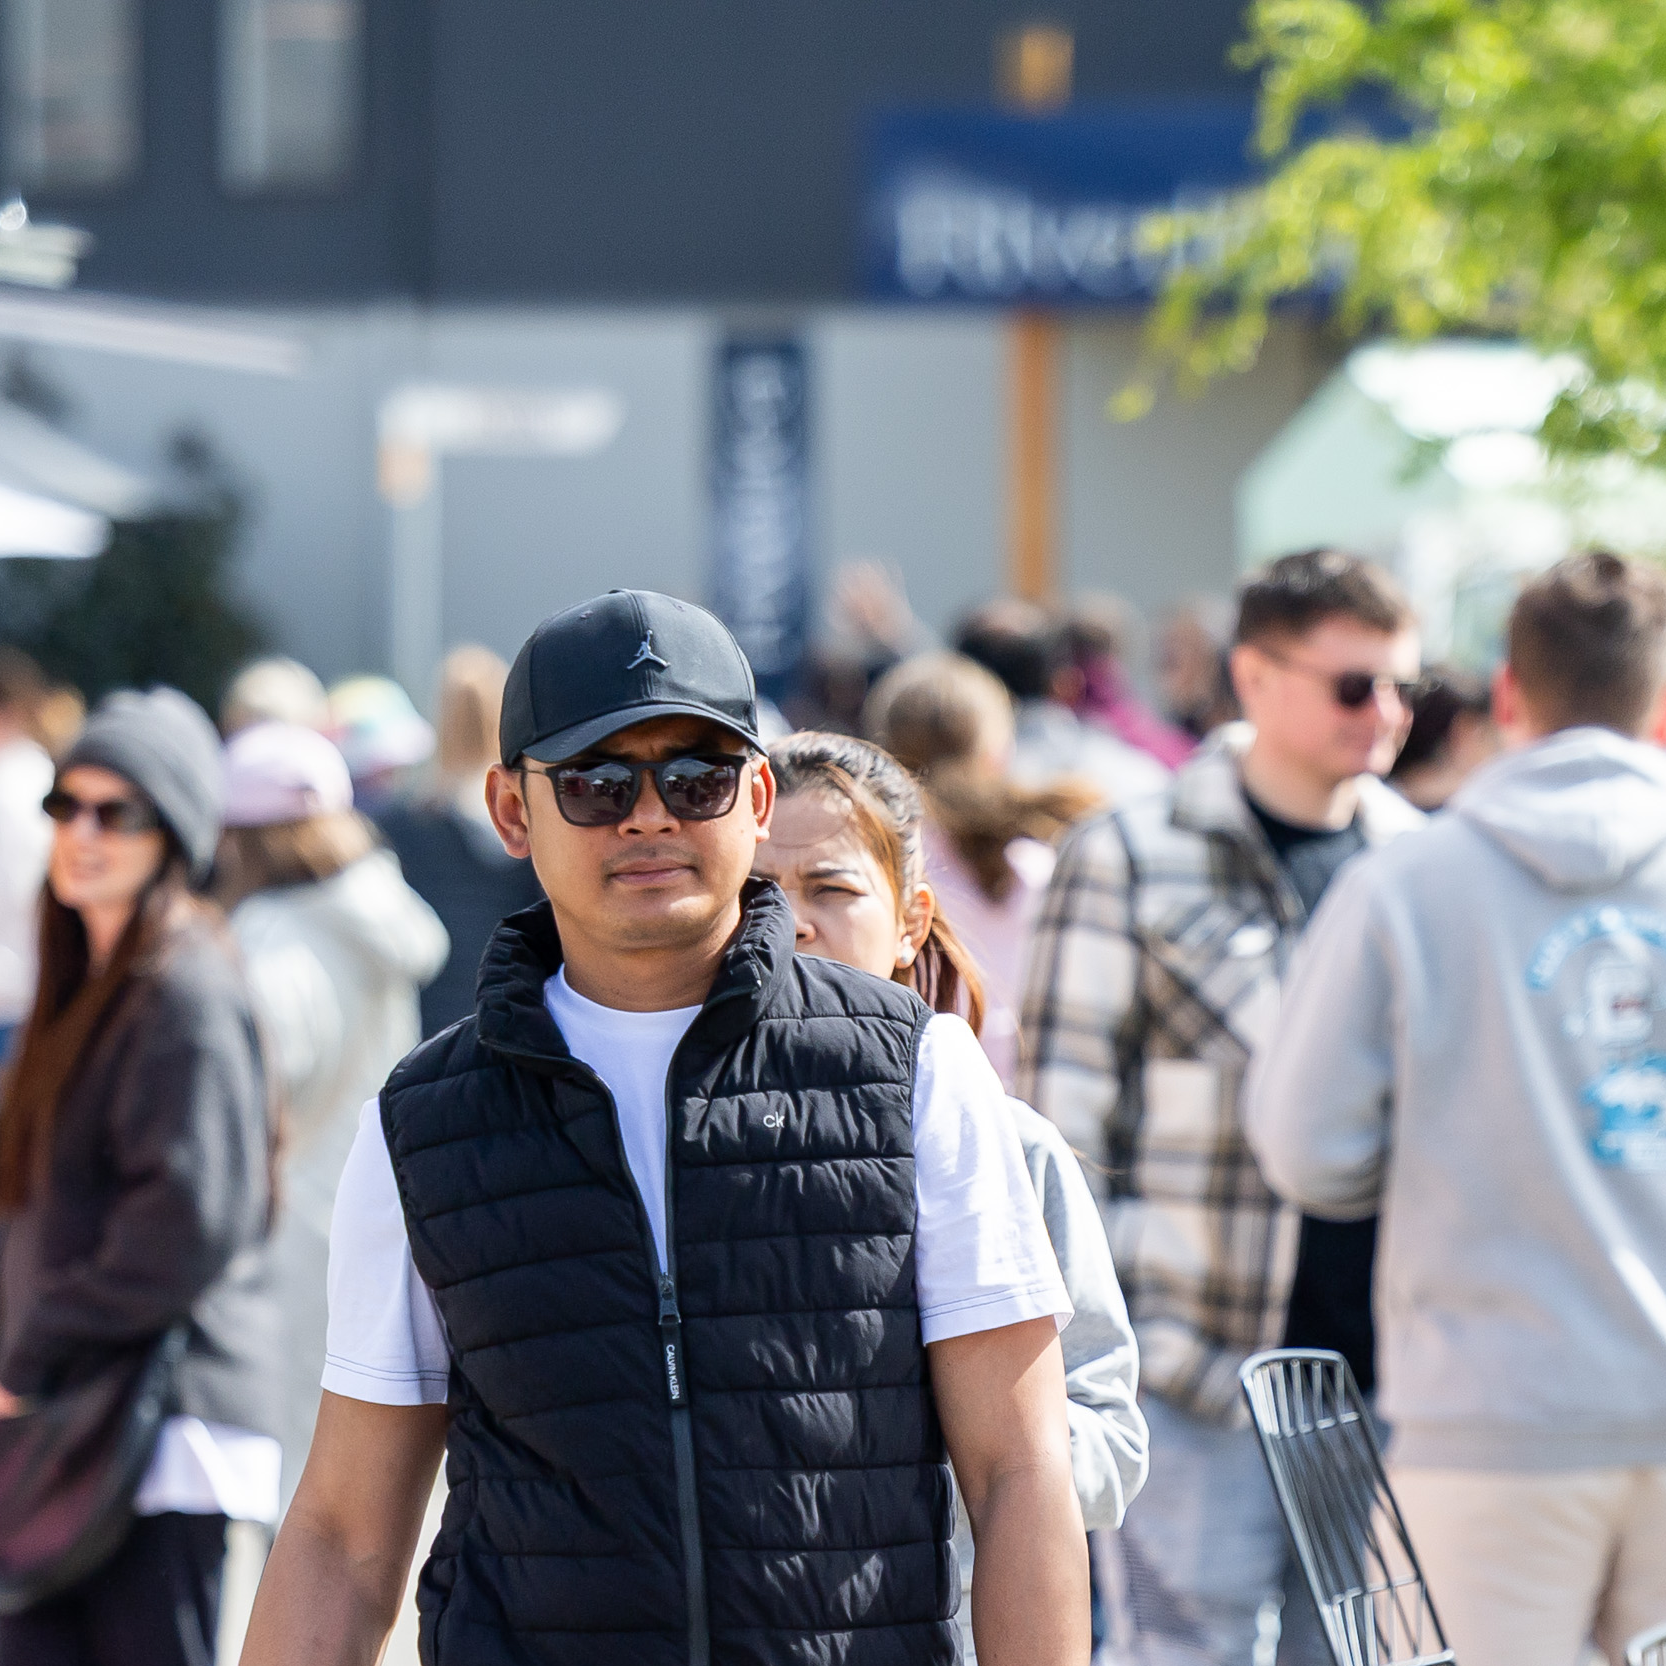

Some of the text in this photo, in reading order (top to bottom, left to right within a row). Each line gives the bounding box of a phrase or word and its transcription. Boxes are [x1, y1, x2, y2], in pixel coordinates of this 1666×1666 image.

[763, 1111, 785, 1128] ck
[666, 1344, 680, 1400] CALVIN KLEIN
